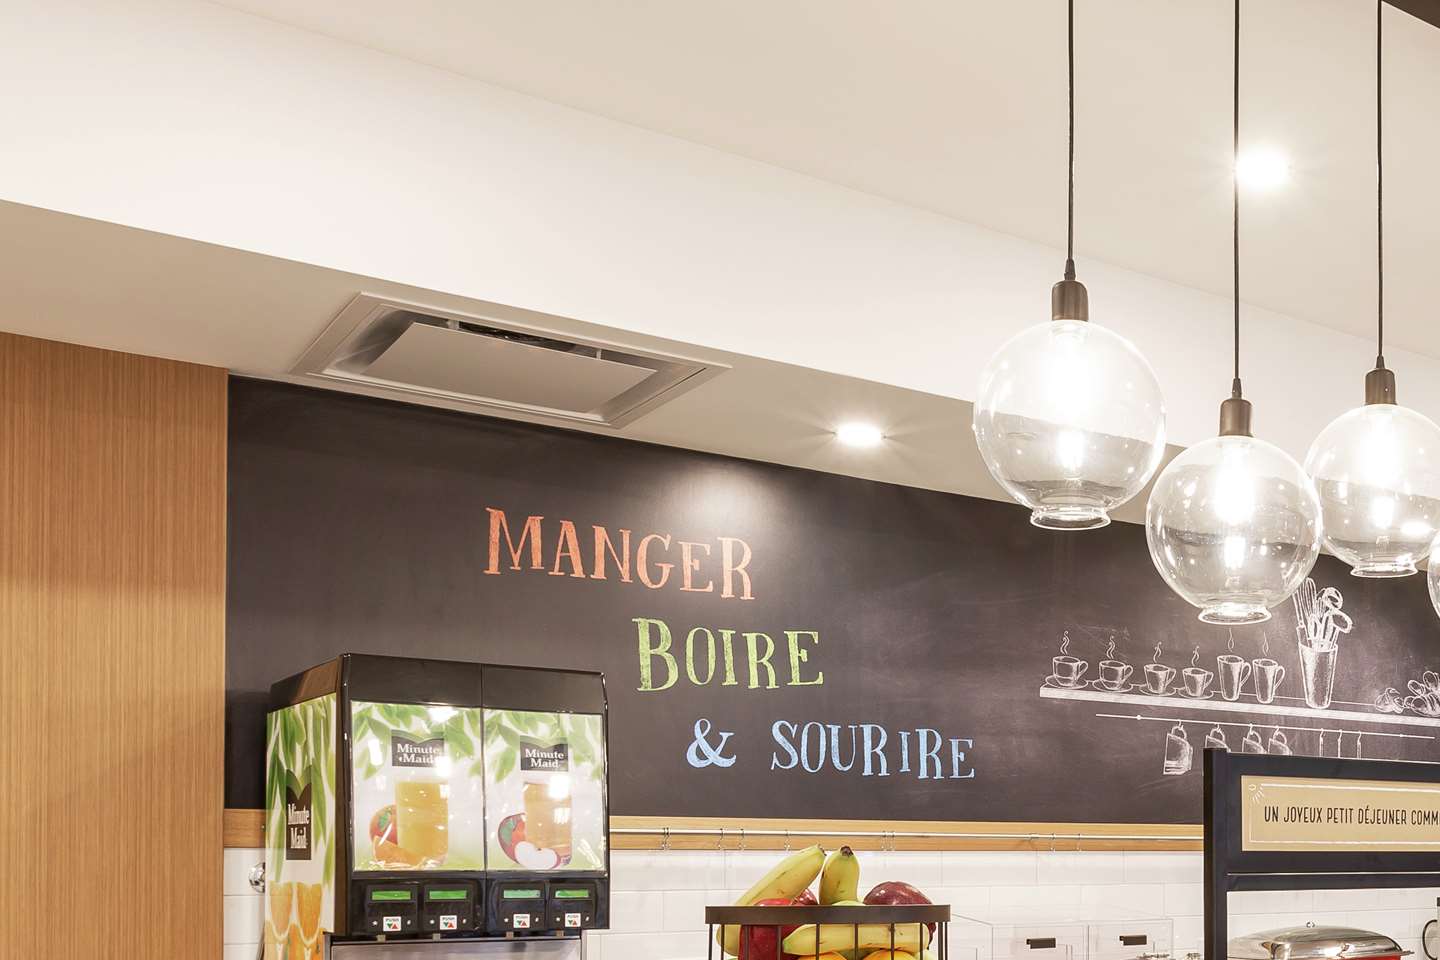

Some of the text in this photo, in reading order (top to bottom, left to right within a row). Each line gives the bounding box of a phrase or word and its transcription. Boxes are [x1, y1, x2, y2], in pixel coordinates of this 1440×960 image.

[483, 507, 755, 600] MANGER
[632, 617, 824, 692] BOIRE
[396, 743, 440, 754] Minute
[402, 752, 434, 764] Maid
[525, 748, 564, 759] Minute
[686, 718, 976, 780] & SOURIRE
[530, 757, 560, 768] Maid
[287, 803, 310, 825] Minute
[1264, 806, 1279, 822] UN
[1283, 806, 1323, 823] JOYEUX
[1327, 807, 1355, 824] PETIT
[1358, 805, 1407, 825] DÉJEUNER
[290, 827, 308, 849] Maid
